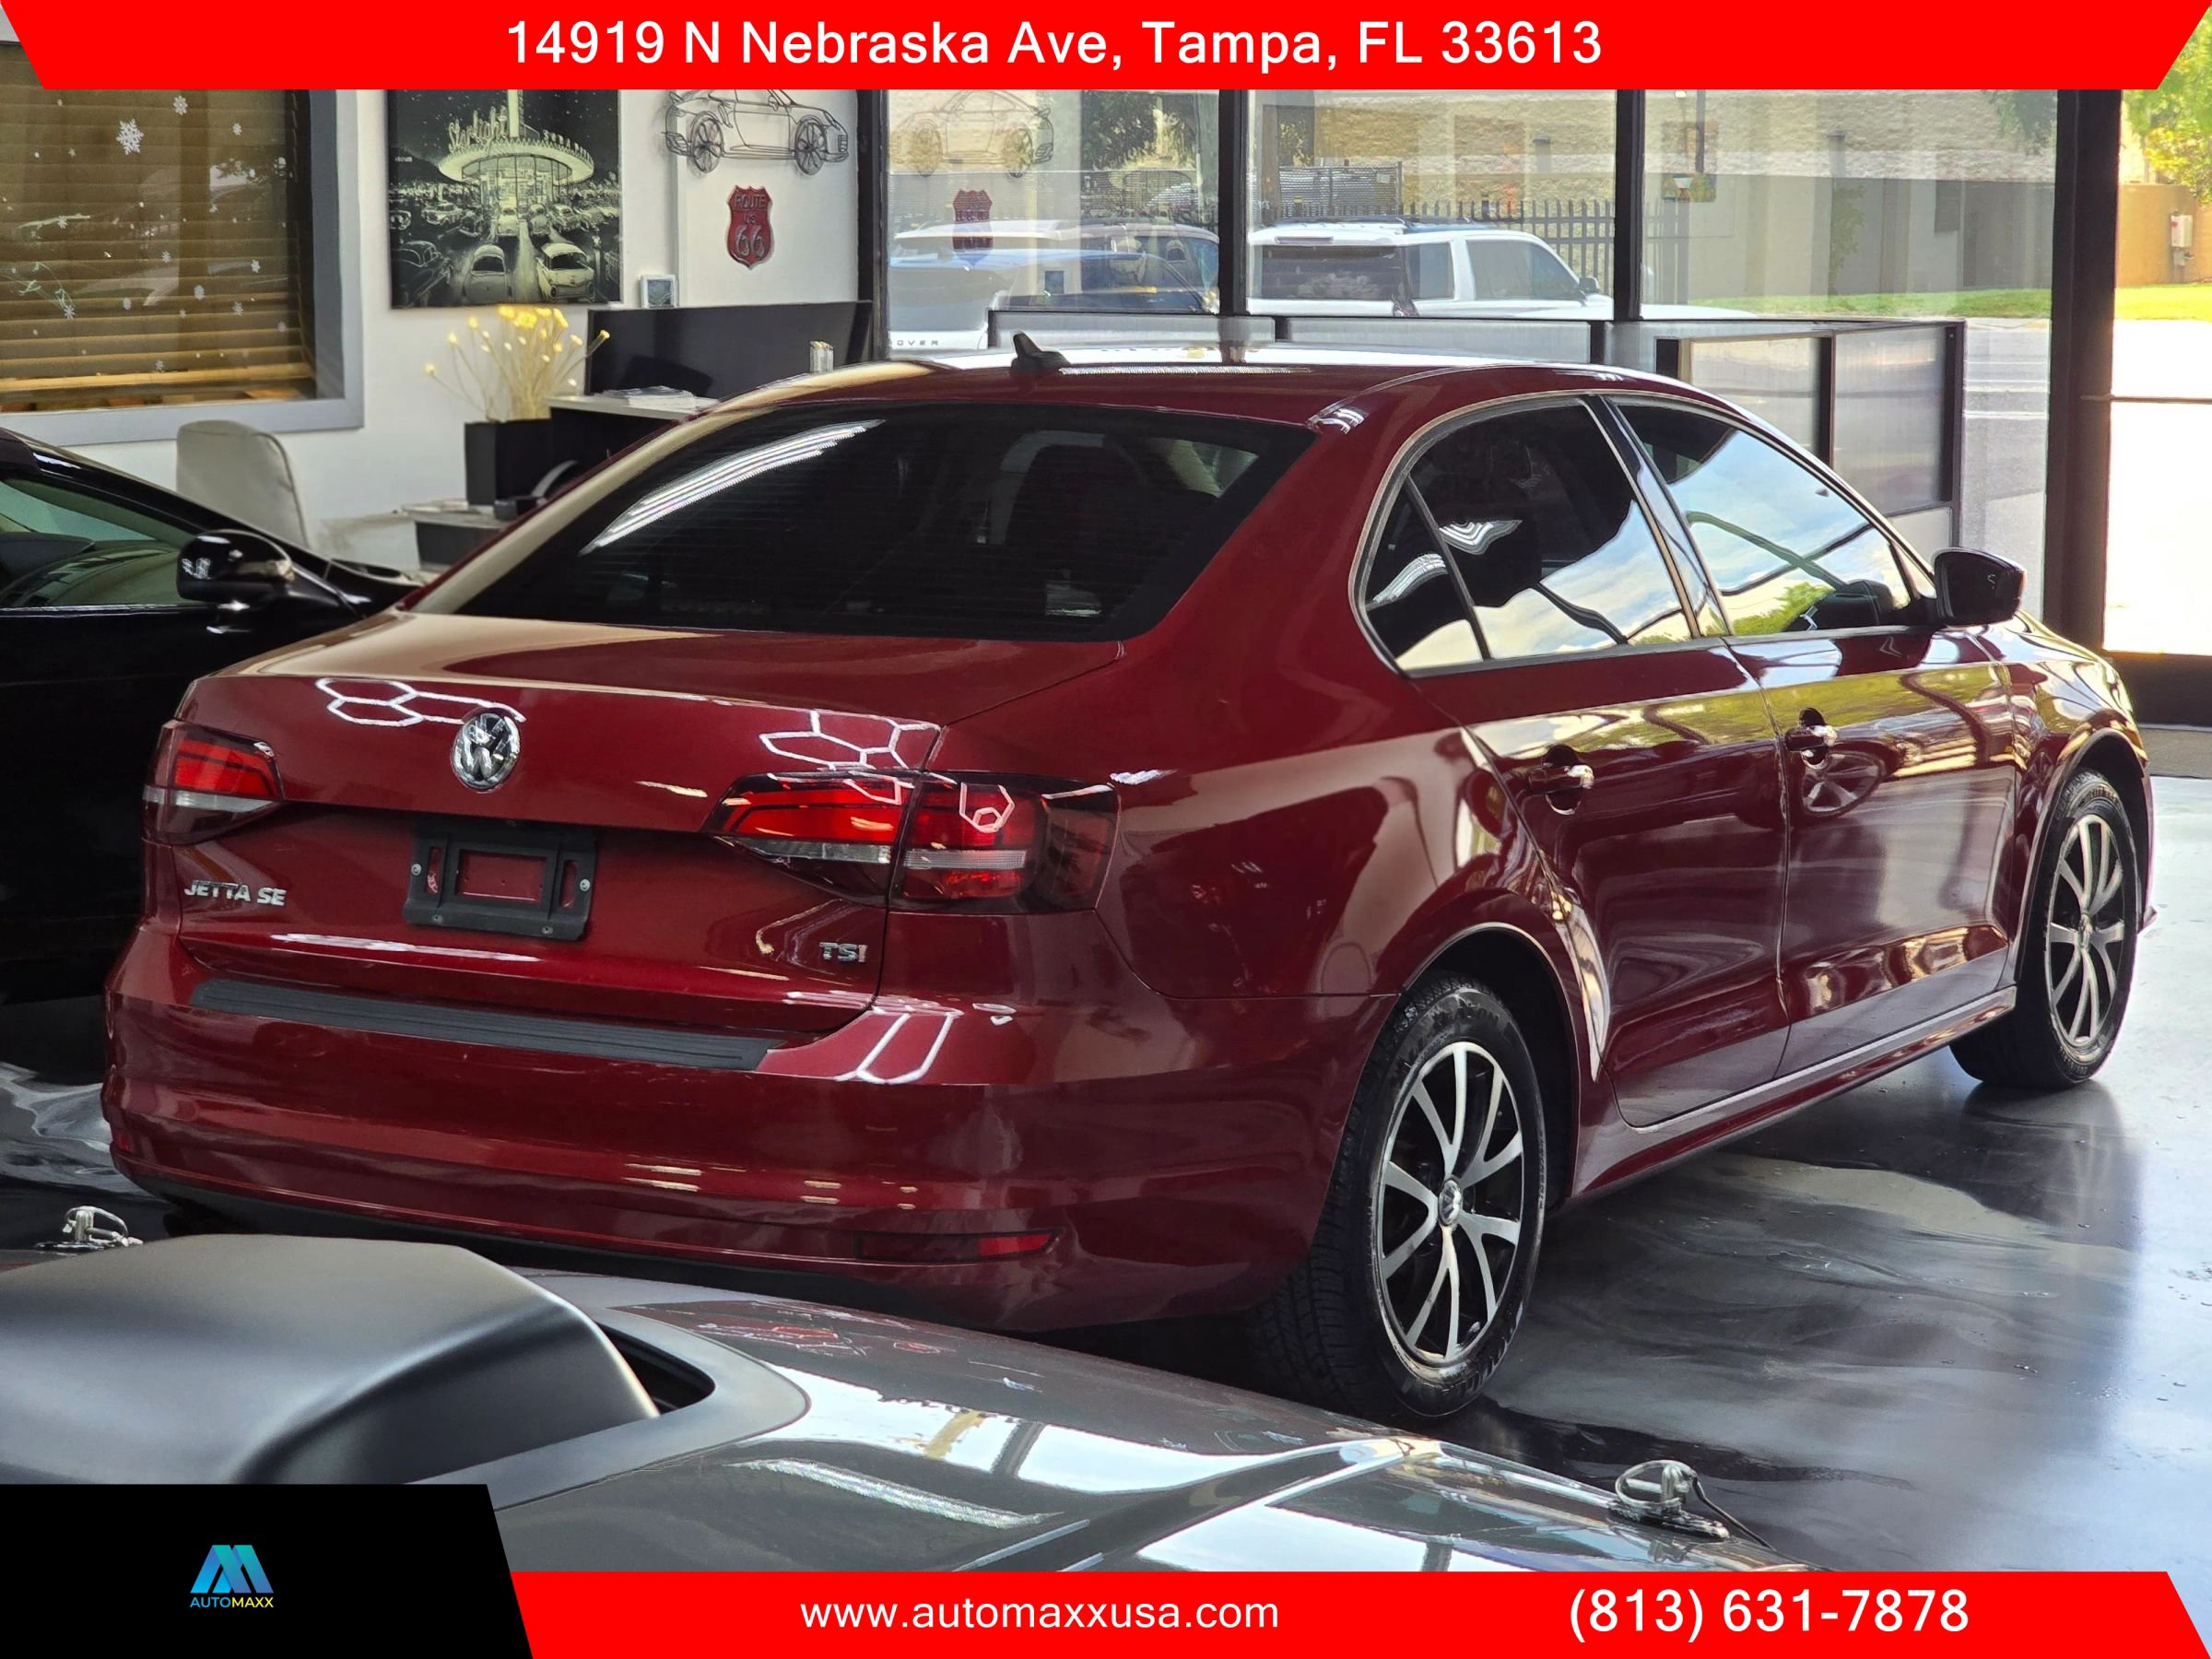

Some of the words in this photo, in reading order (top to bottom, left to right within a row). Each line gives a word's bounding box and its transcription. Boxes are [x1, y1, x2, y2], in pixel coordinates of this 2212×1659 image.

[735, 194, 766, 208] ROUTE
[736, 225, 764, 257] 66
[184, 879, 251, 901] JETTA
[257, 887, 287, 907] SE
[819, 941, 867, 962] TSI
